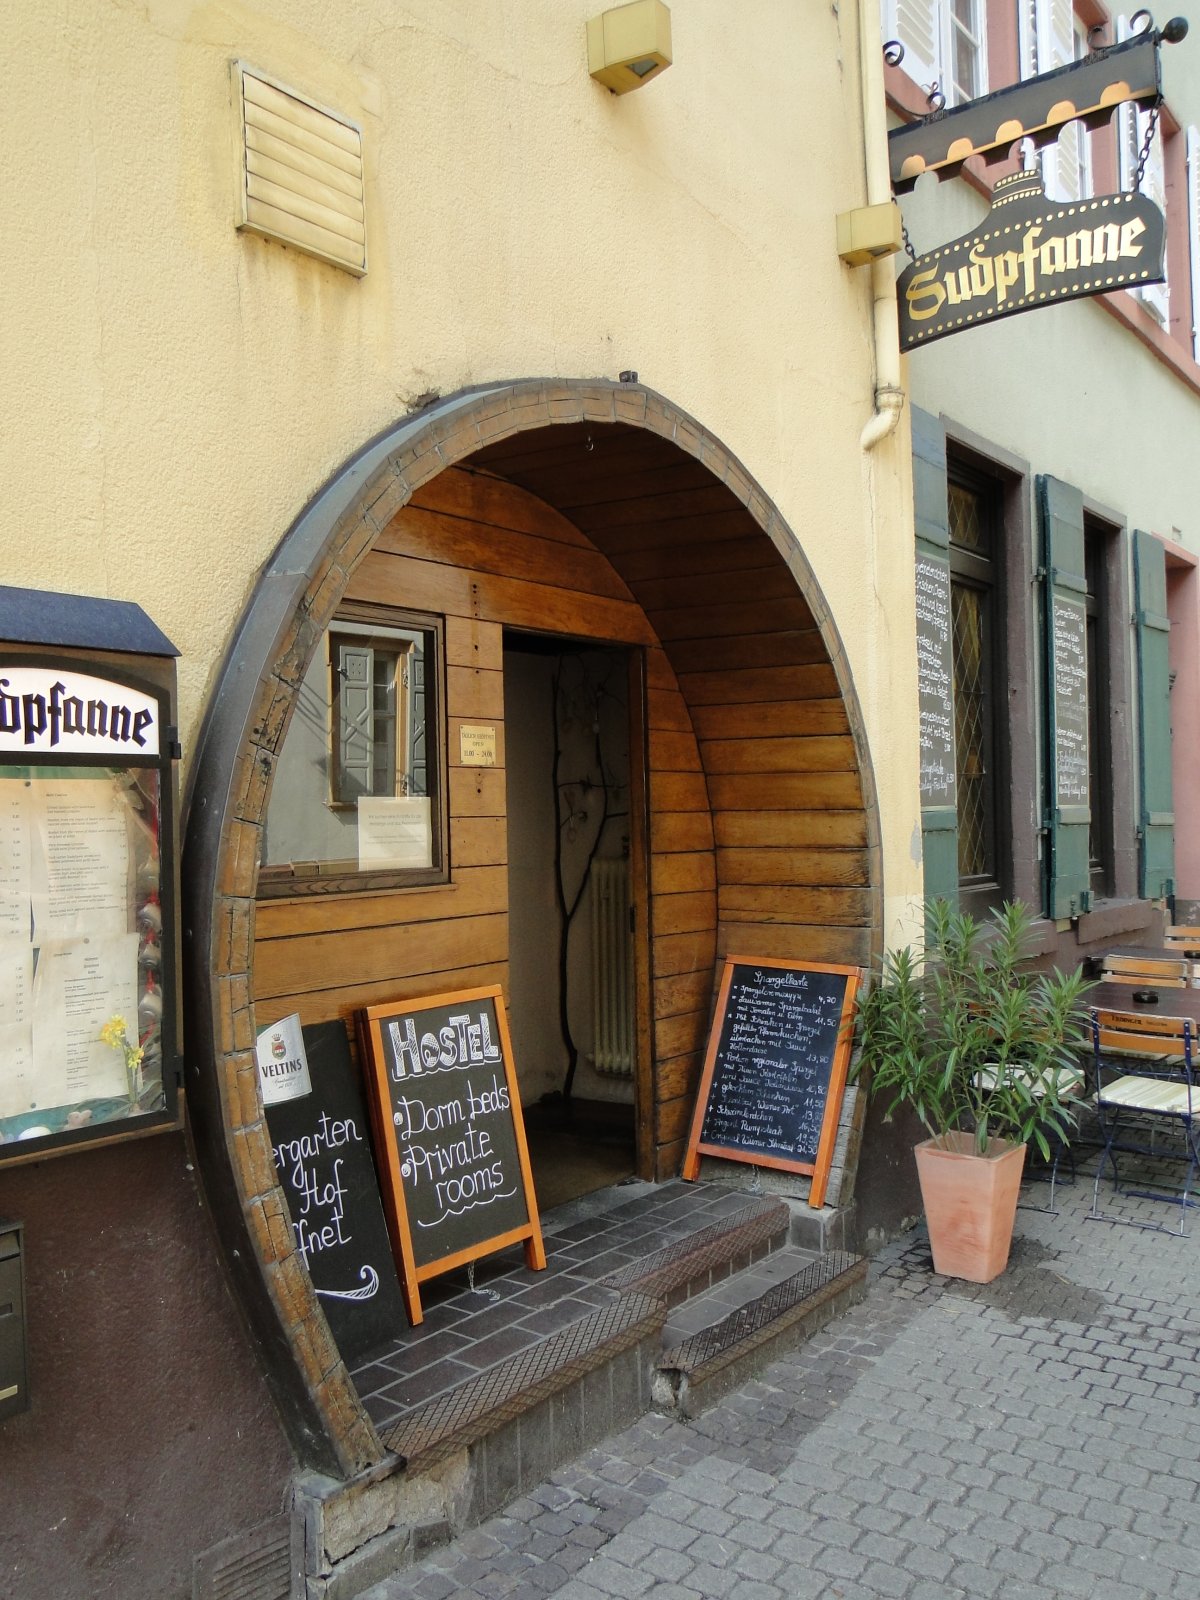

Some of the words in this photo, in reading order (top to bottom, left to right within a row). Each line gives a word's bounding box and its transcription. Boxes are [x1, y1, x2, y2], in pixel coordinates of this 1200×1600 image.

[905, 217, 1147, 321] Sudpfanne
[262, 1058, 302, 1078] VELTINS
[397, 1095, 465, 1140] Dorm
[466, 1074, 509, 1120] beds
[402, 1122, 494, 1186] Private
[299, 1158, 348, 1216] Hof
[436, 1161, 504, 1209] rooms
